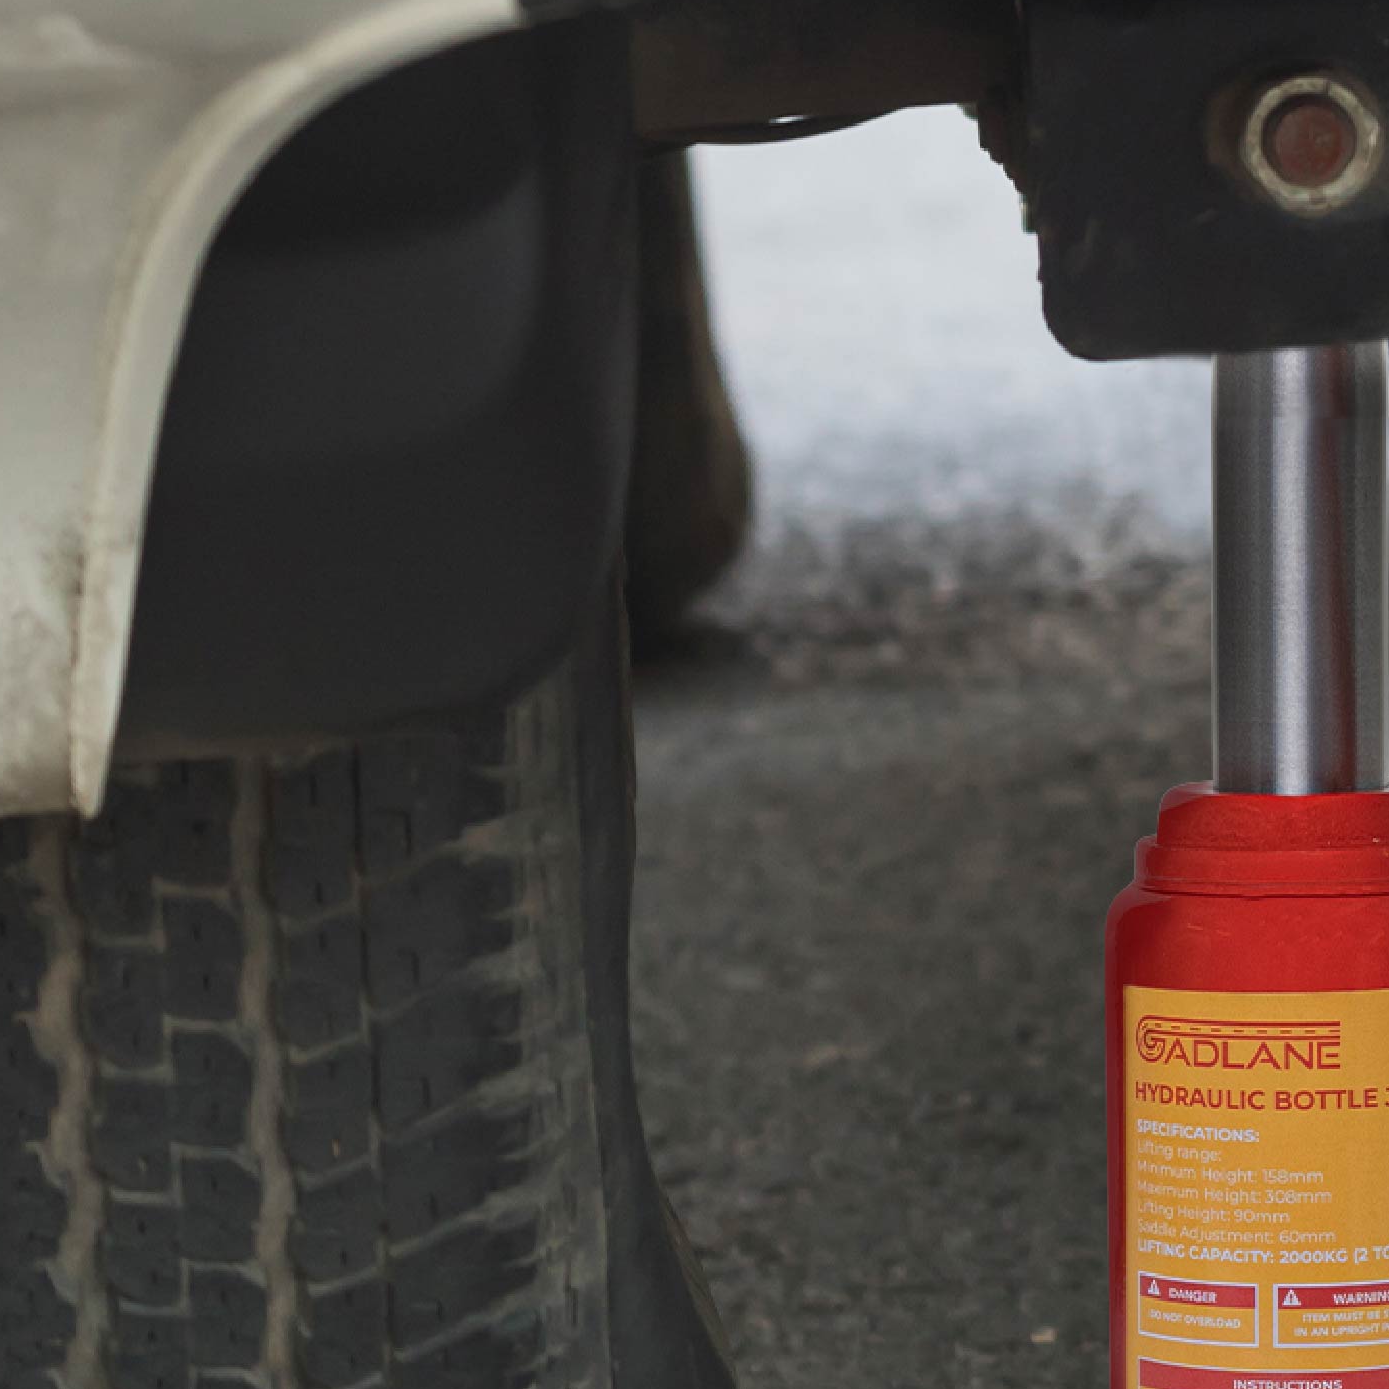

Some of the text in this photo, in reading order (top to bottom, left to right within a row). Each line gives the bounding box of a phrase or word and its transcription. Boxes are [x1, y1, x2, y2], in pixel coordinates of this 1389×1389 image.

[1136, 1021, 1341, 1070] GADLANE
[1135, 1081, 1266, 1110] HYDRAULIC
[1274, 1089, 1379, 1110] BOTTLE
[1137, 1118, 1260, 1143] SPECIFICATIONS:
[1177, 1147, 1222, 1163] range:
[1233, 1208, 1291, 1223] 90mm
[1279, 1230, 1337, 1245] 60mm
[1137, 1237, 1185, 1259] LIFTING
[1189, 1246, 1274, 1264] CAPACITY:
[1279, 1249, 1348, 1264] 2000KG
